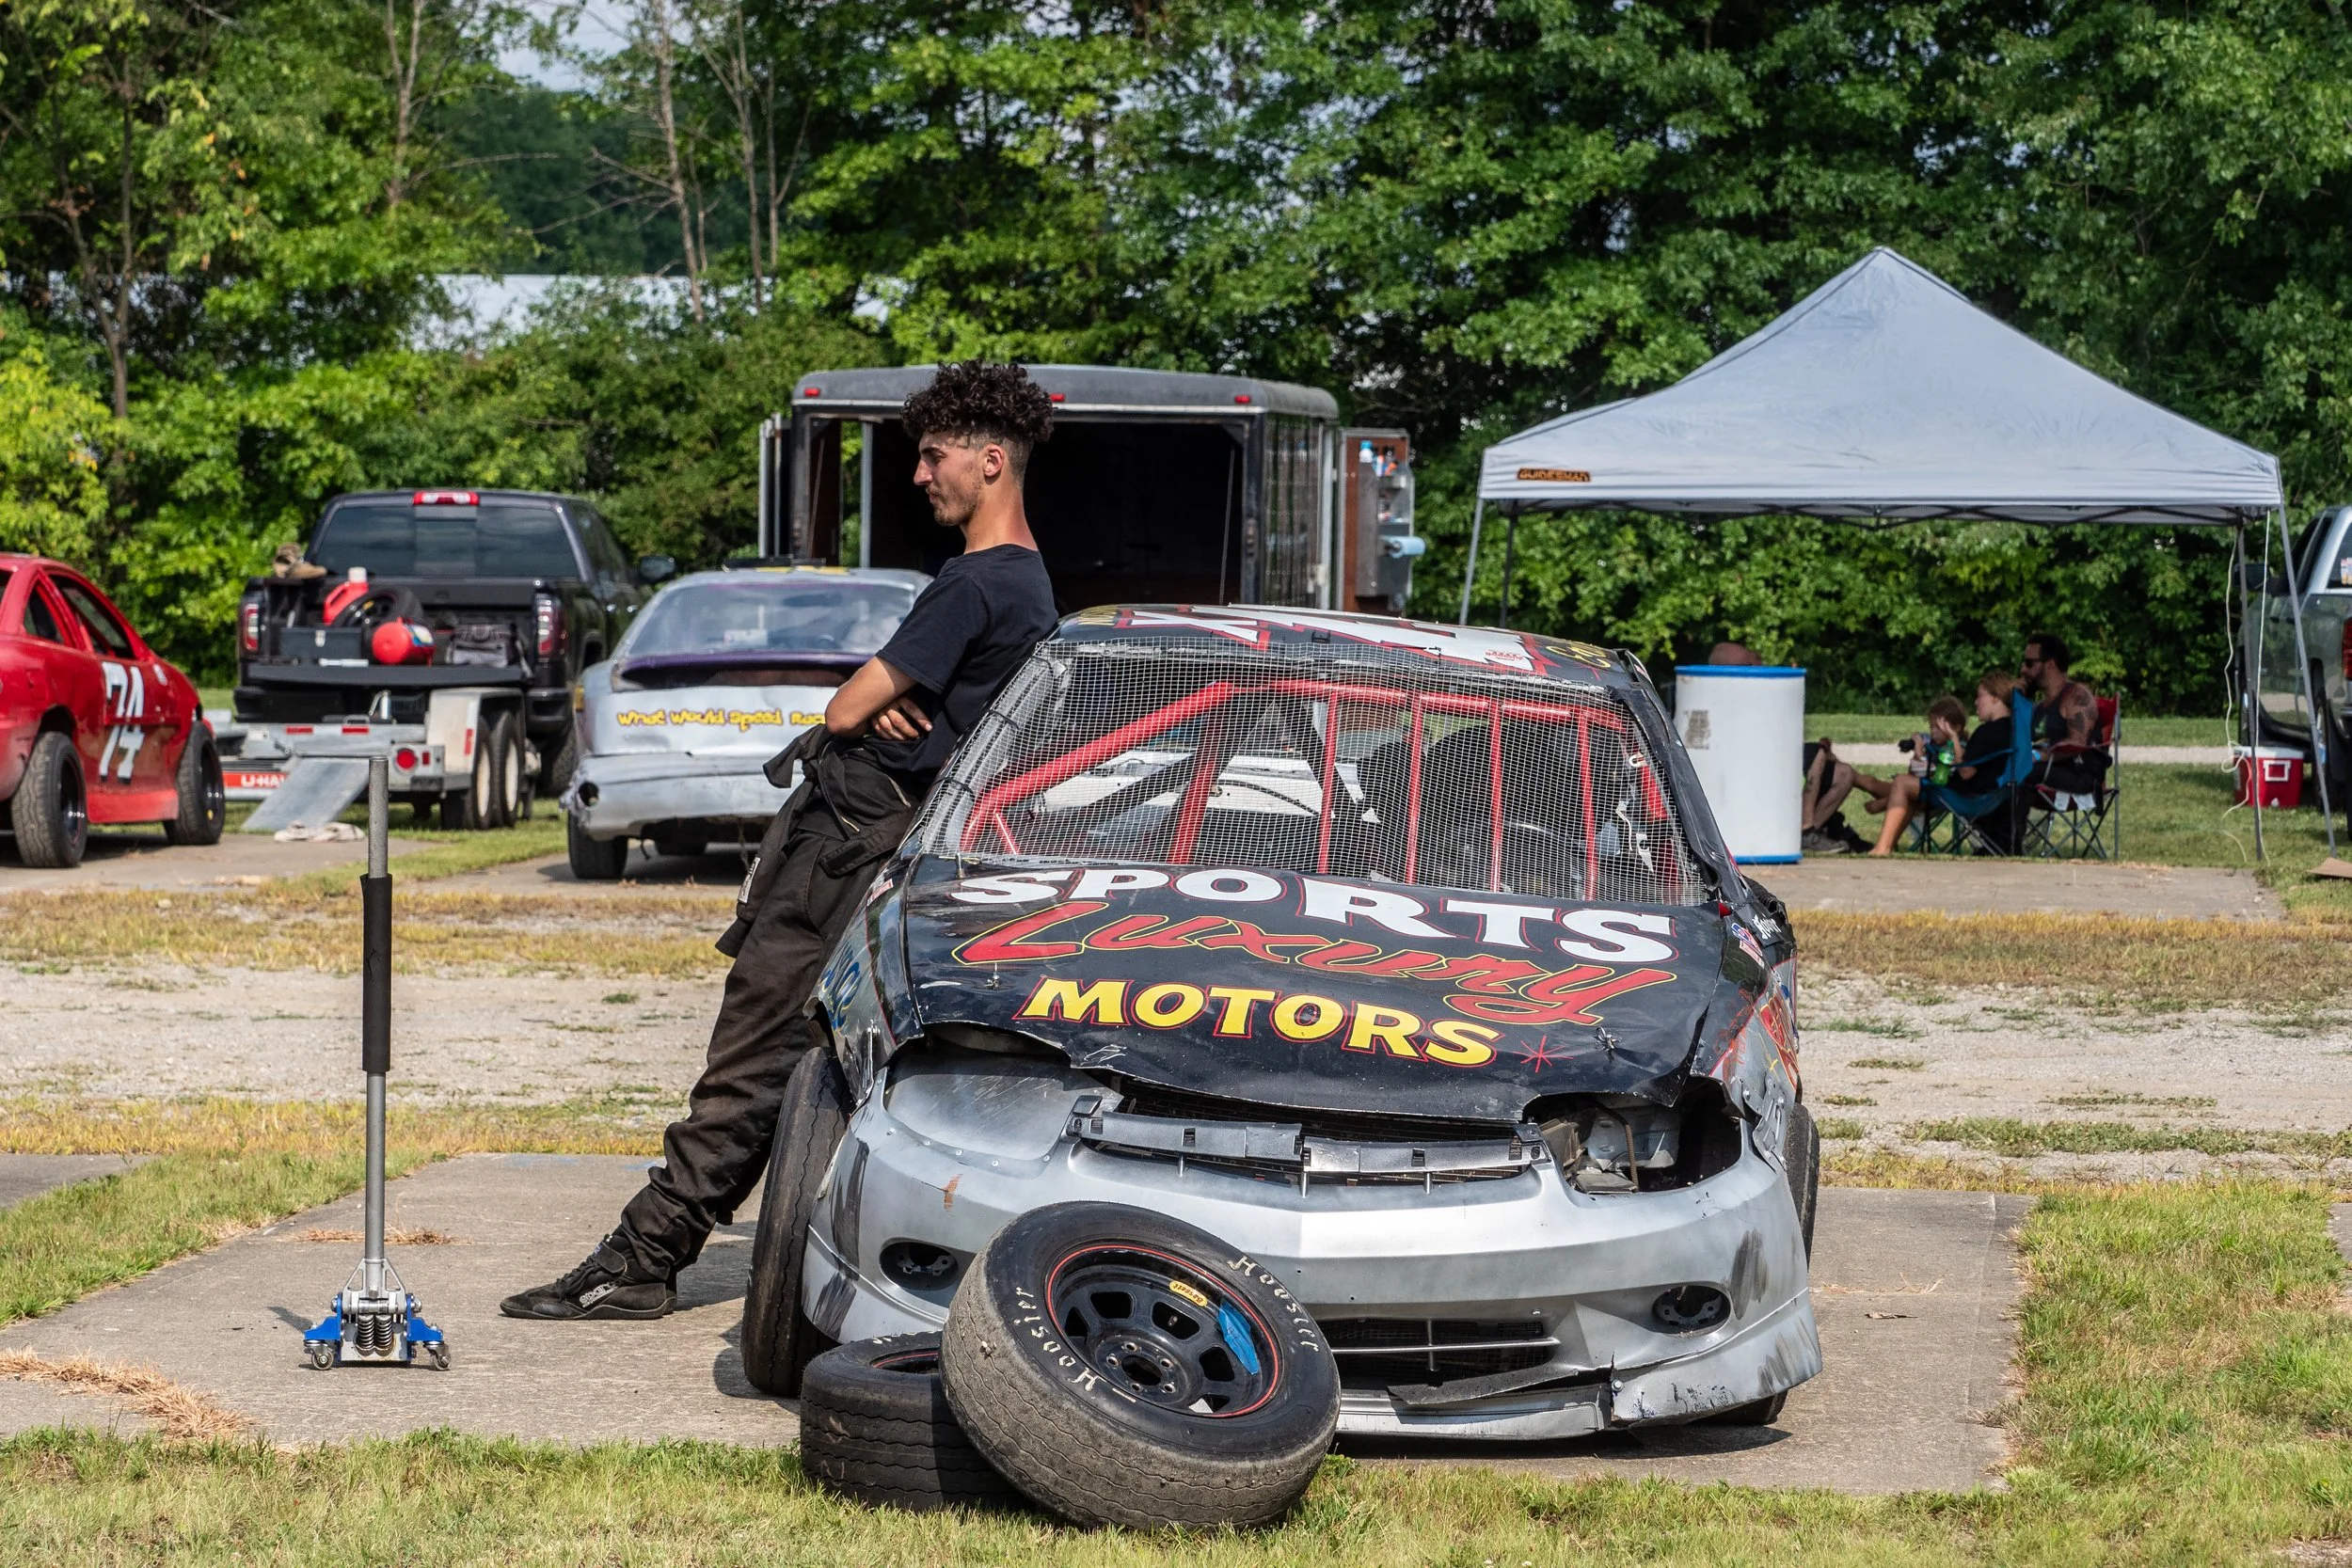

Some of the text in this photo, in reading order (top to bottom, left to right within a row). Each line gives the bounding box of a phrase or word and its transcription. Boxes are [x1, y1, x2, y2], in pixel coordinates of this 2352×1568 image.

[99, 661, 145, 784] 74
[617, 708, 666, 726] What
[670, 708, 725, 726] Would
[728, 708, 783, 733] Speed
[241, 773, 286, 787] U-HA
[949, 868, 1677, 962] SPORTS
[951, 901, 1677, 1026] Luxury
[1014, 978, 1503, 1067] MOTORS
[1013, 1286, 1107, 1392] Hoosier
[1227, 1255, 1319, 1353] Hoosier
